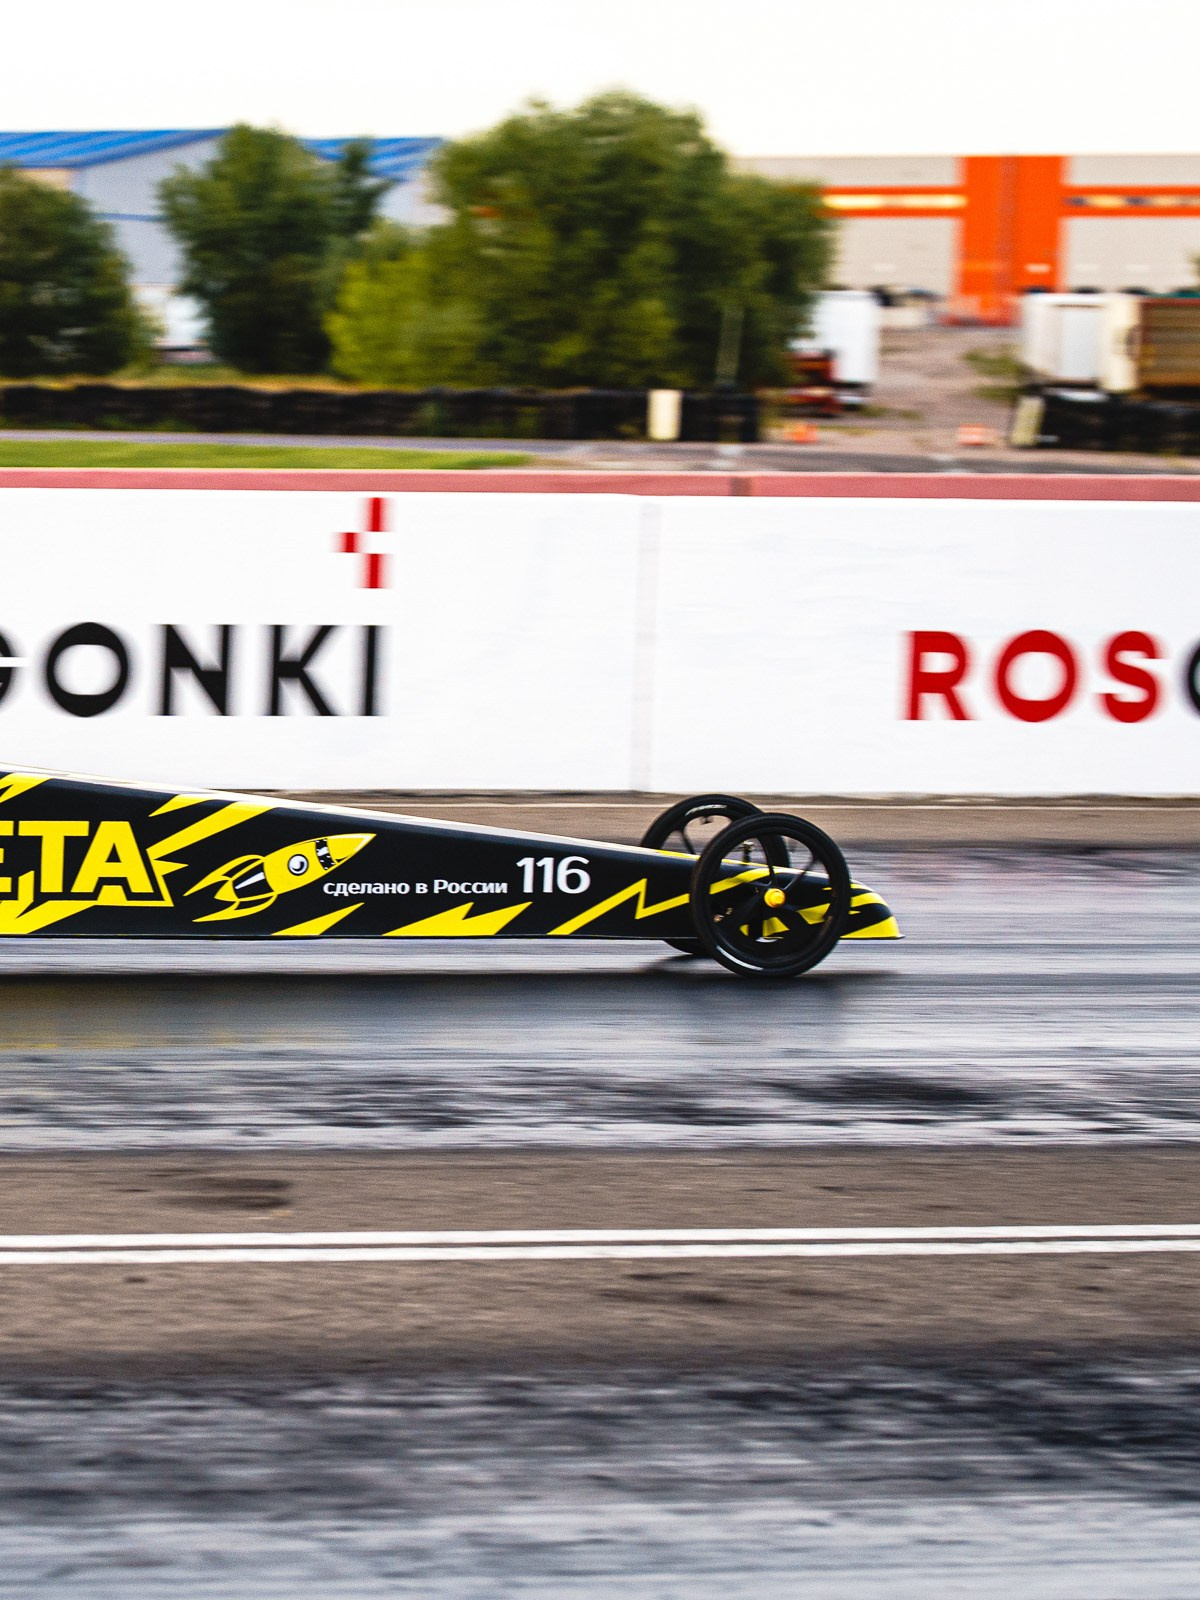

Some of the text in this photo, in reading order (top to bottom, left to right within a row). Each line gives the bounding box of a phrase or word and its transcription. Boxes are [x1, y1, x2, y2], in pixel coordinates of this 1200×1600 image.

[900, 629, 1200, 723] ROS
[323, 879, 508, 896] сделано в России
[516, 856, 591, 894] 116
